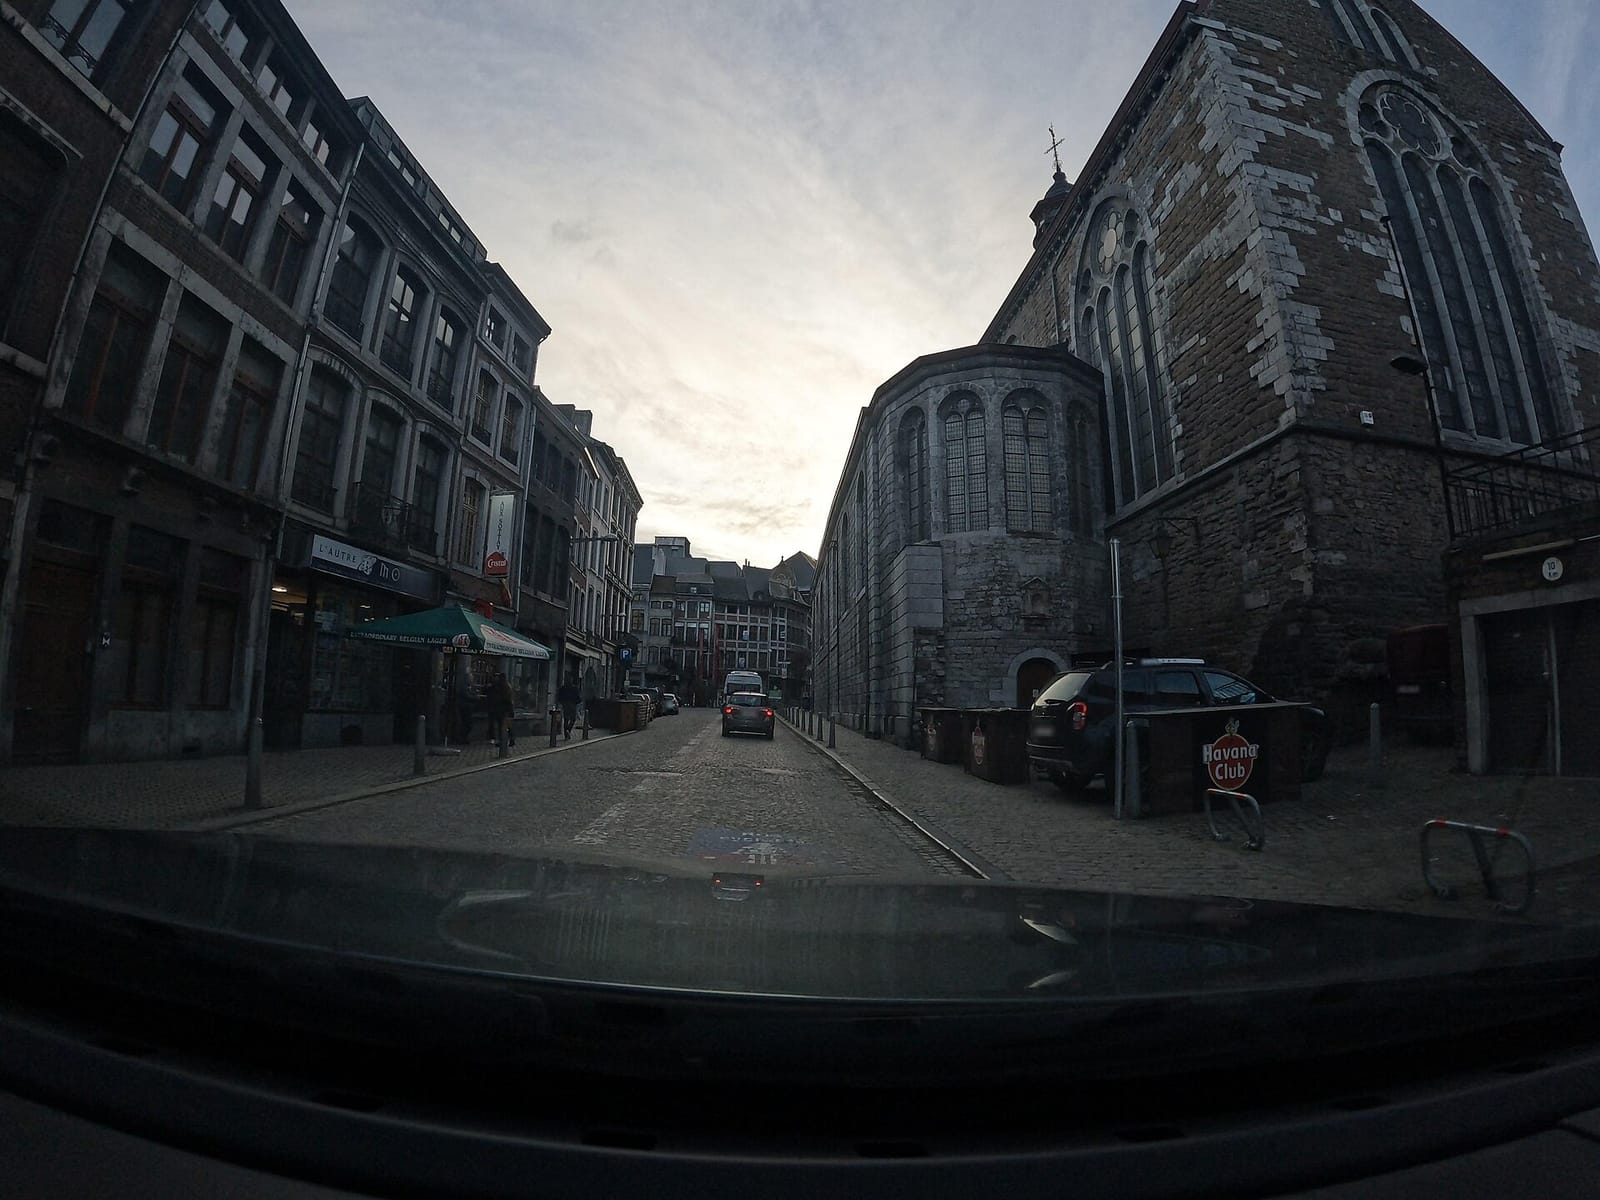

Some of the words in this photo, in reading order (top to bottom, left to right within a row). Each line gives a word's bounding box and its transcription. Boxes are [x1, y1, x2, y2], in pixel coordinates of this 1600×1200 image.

[622, 649, 630, 660] P
[1202, 744, 1259, 764] Havana
[1215, 762, 1246, 780] Club
